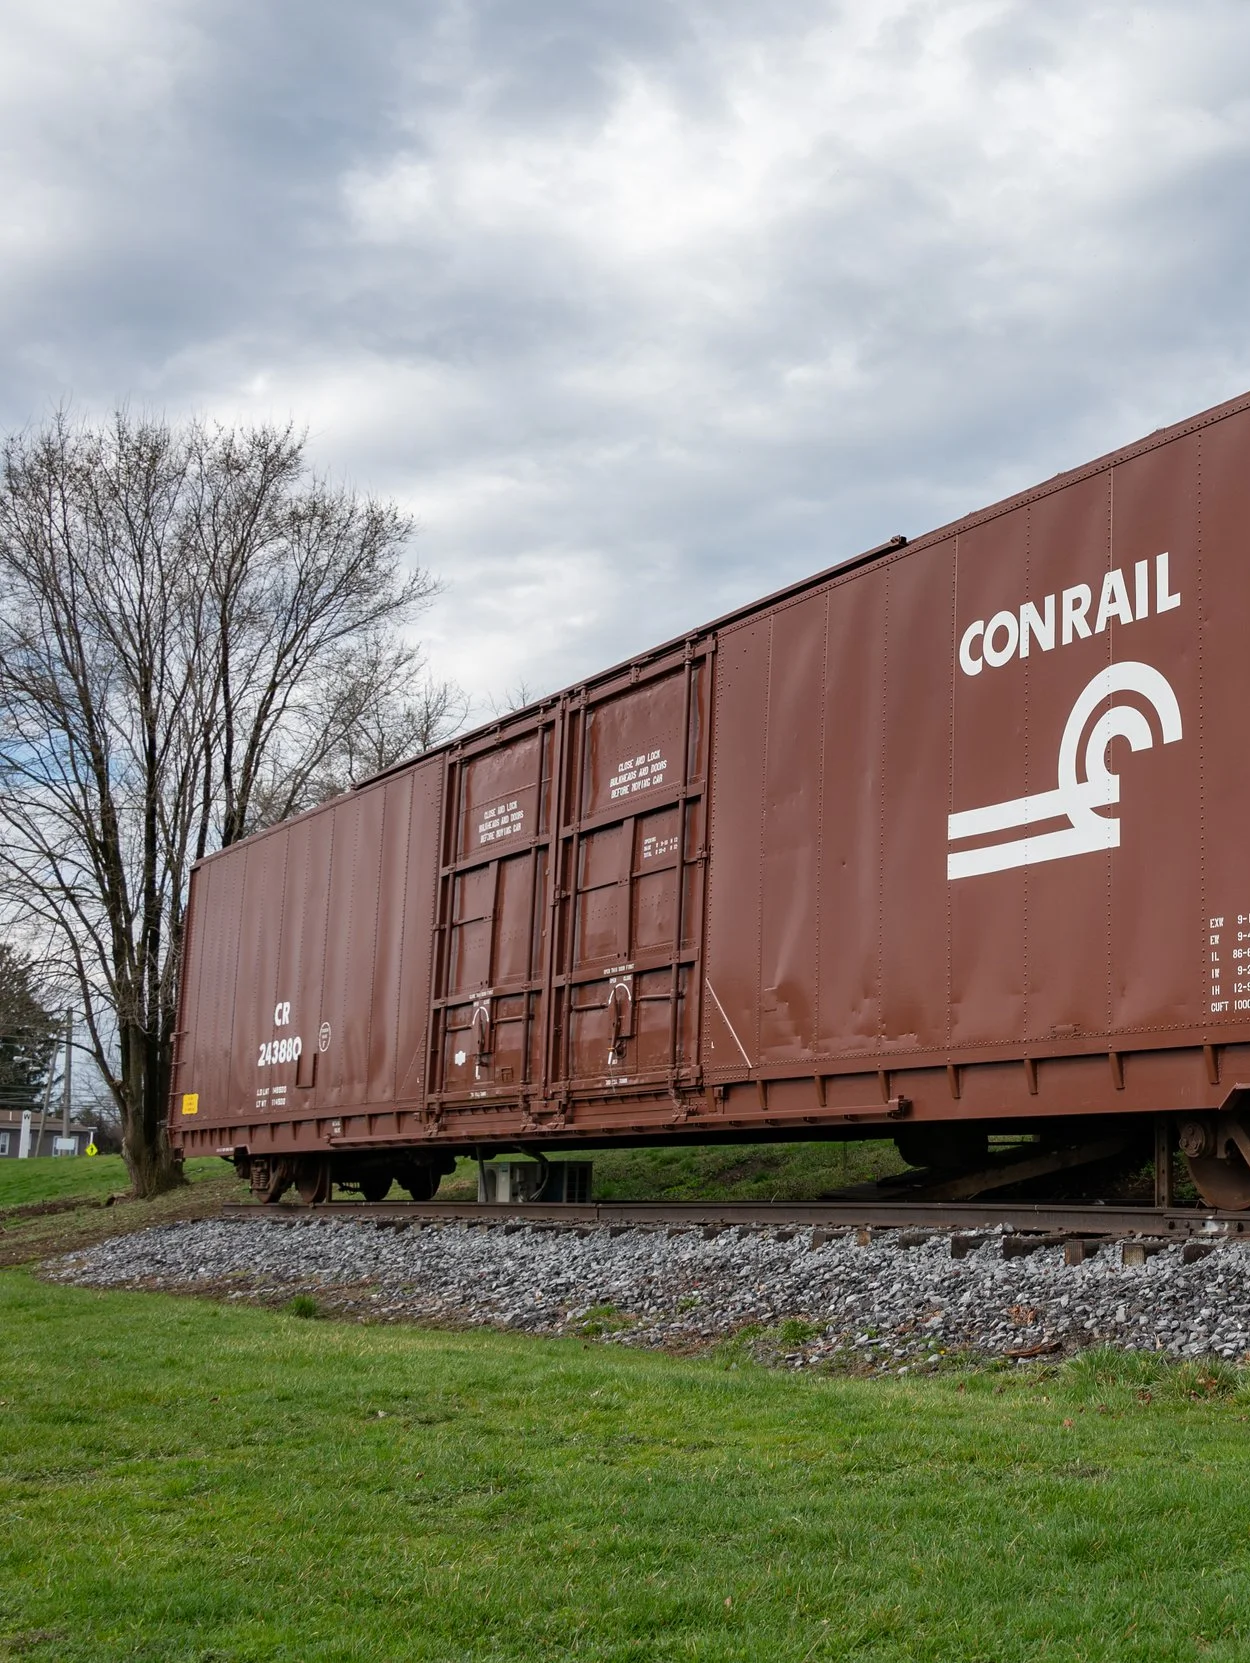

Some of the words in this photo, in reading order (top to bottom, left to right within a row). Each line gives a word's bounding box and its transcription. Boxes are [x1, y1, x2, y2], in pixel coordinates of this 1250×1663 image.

[959, 551, 1181, 677] CONRAIL
[635, 755, 645, 766] AND
[638, 766, 649, 777] AND
[1211, 951, 1220, 961] IL
[1211, 985, 1220, 995] IH
[1210, 1001, 1229, 1012] CUFT
[274, 1001, 290, 1026] CR
[257, 1036, 302, 1067] 243880
